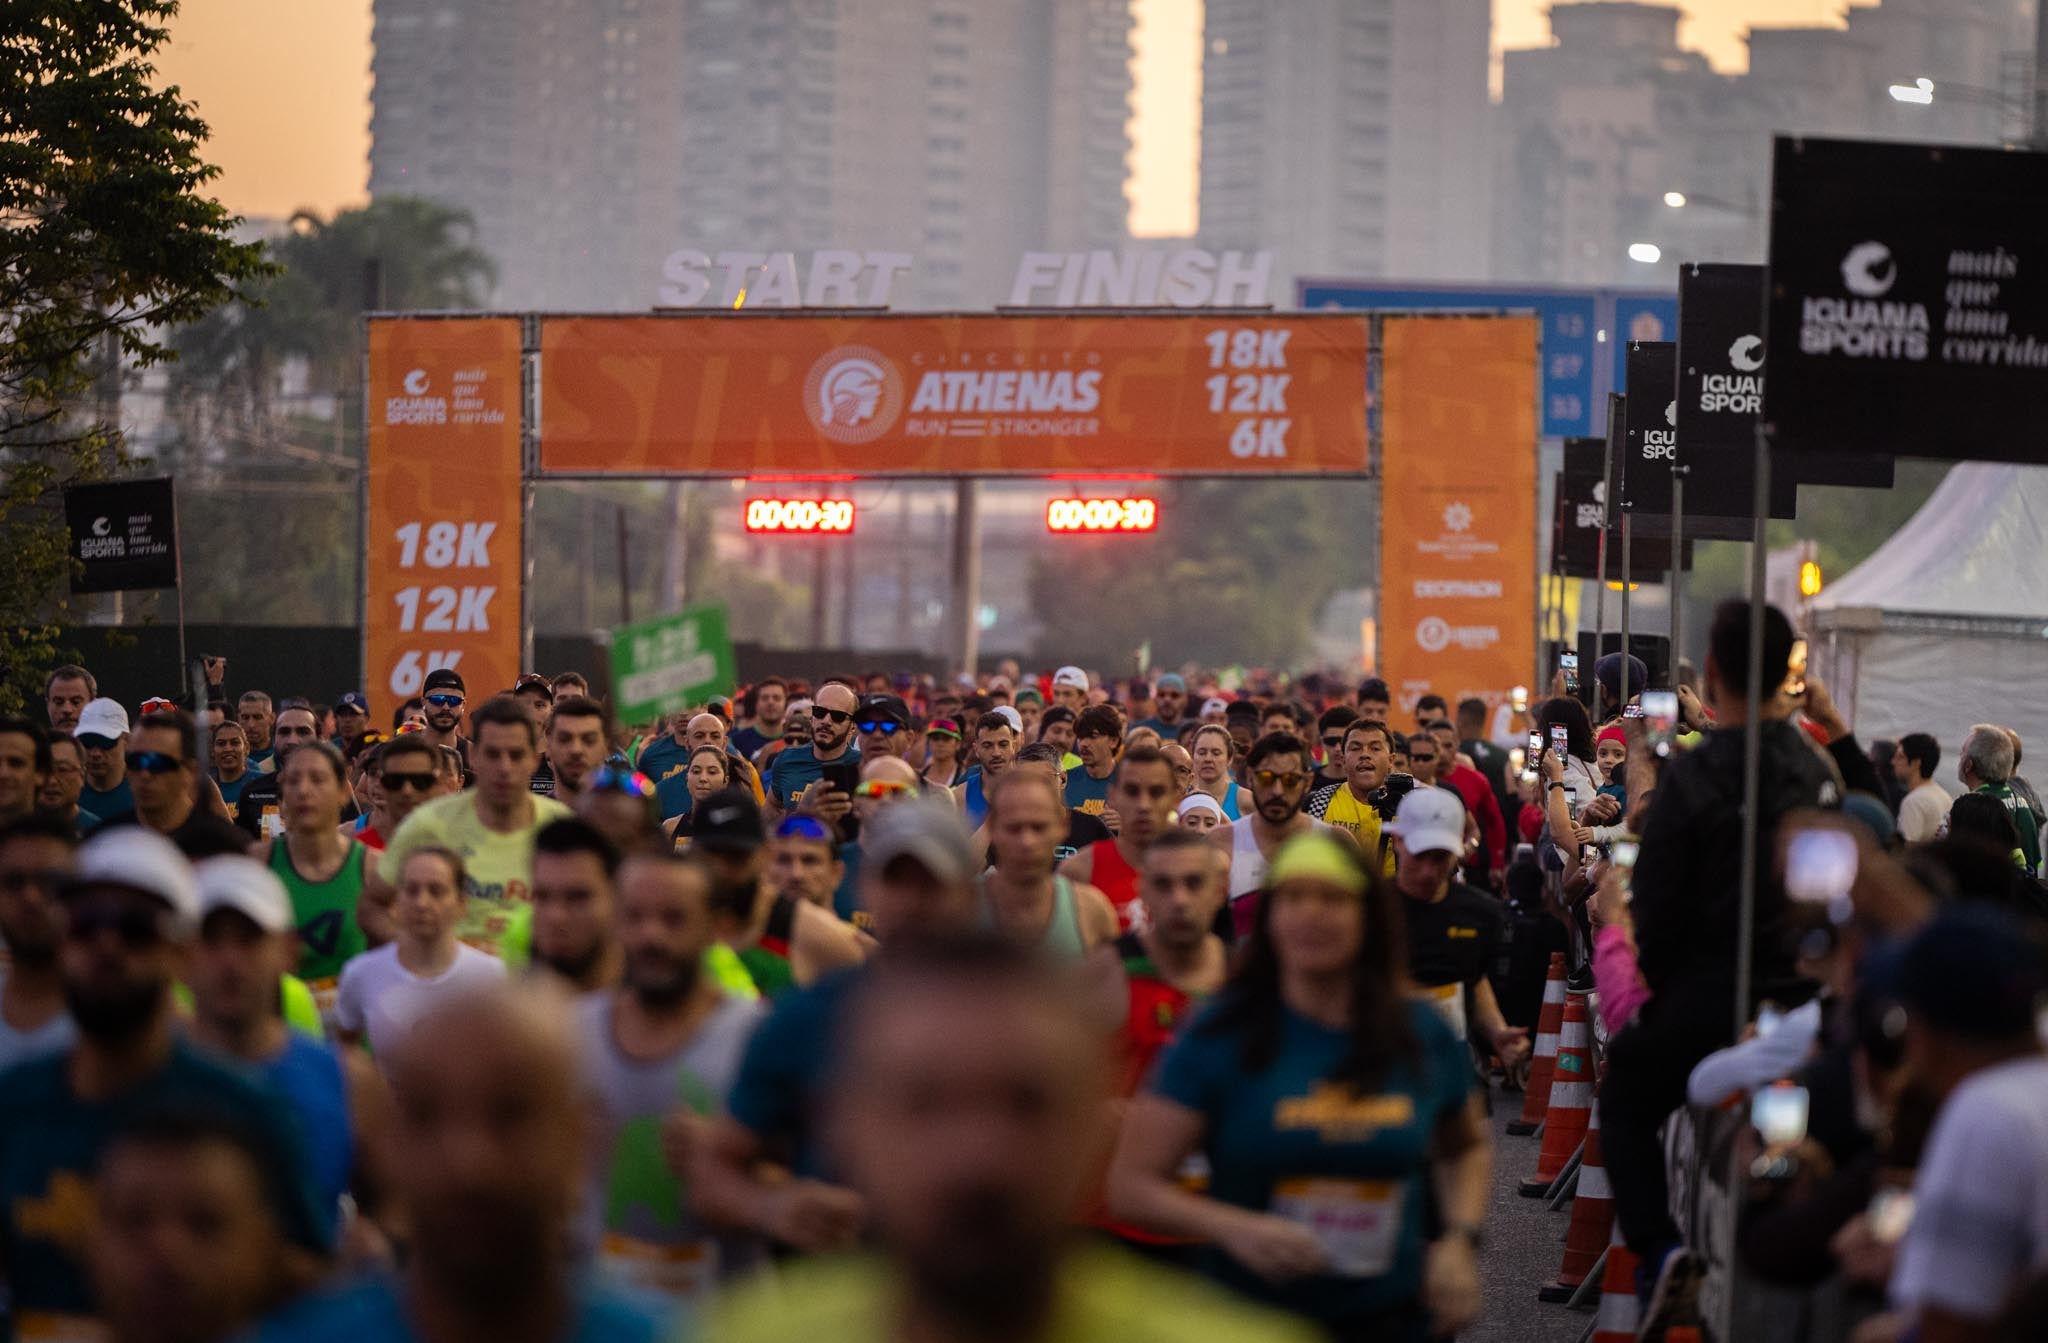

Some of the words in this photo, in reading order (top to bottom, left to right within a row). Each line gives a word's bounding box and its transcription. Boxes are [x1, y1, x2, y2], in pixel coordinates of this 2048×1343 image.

[659, 249, 912, 306] START
[1009, 250, 1272, 306] FINISH
[1802, 297, 1929, 331] IGUANA
[1205, 329, 1293, 368] 18K
[1801, 325, 1929, 360] SPORTS
[387, 397, 446, 410] IGUANA
[910, 370, 1103, 412] ATHENAS
[1205, 374, 1293, 413] 12K
[386, 410, 446, 425] SPORTS
[906, 418, 947, 435] RUN
[991, 418, 1099, 435] STRONGER
[1230, 419, 1292, 458] 6K
[81, 536, 125, 548] IGUANA
[81, 546, 125, 559] SPORTS
[395, 521, 498, 568] 18K
[394, 586, 497, 632] 12K
